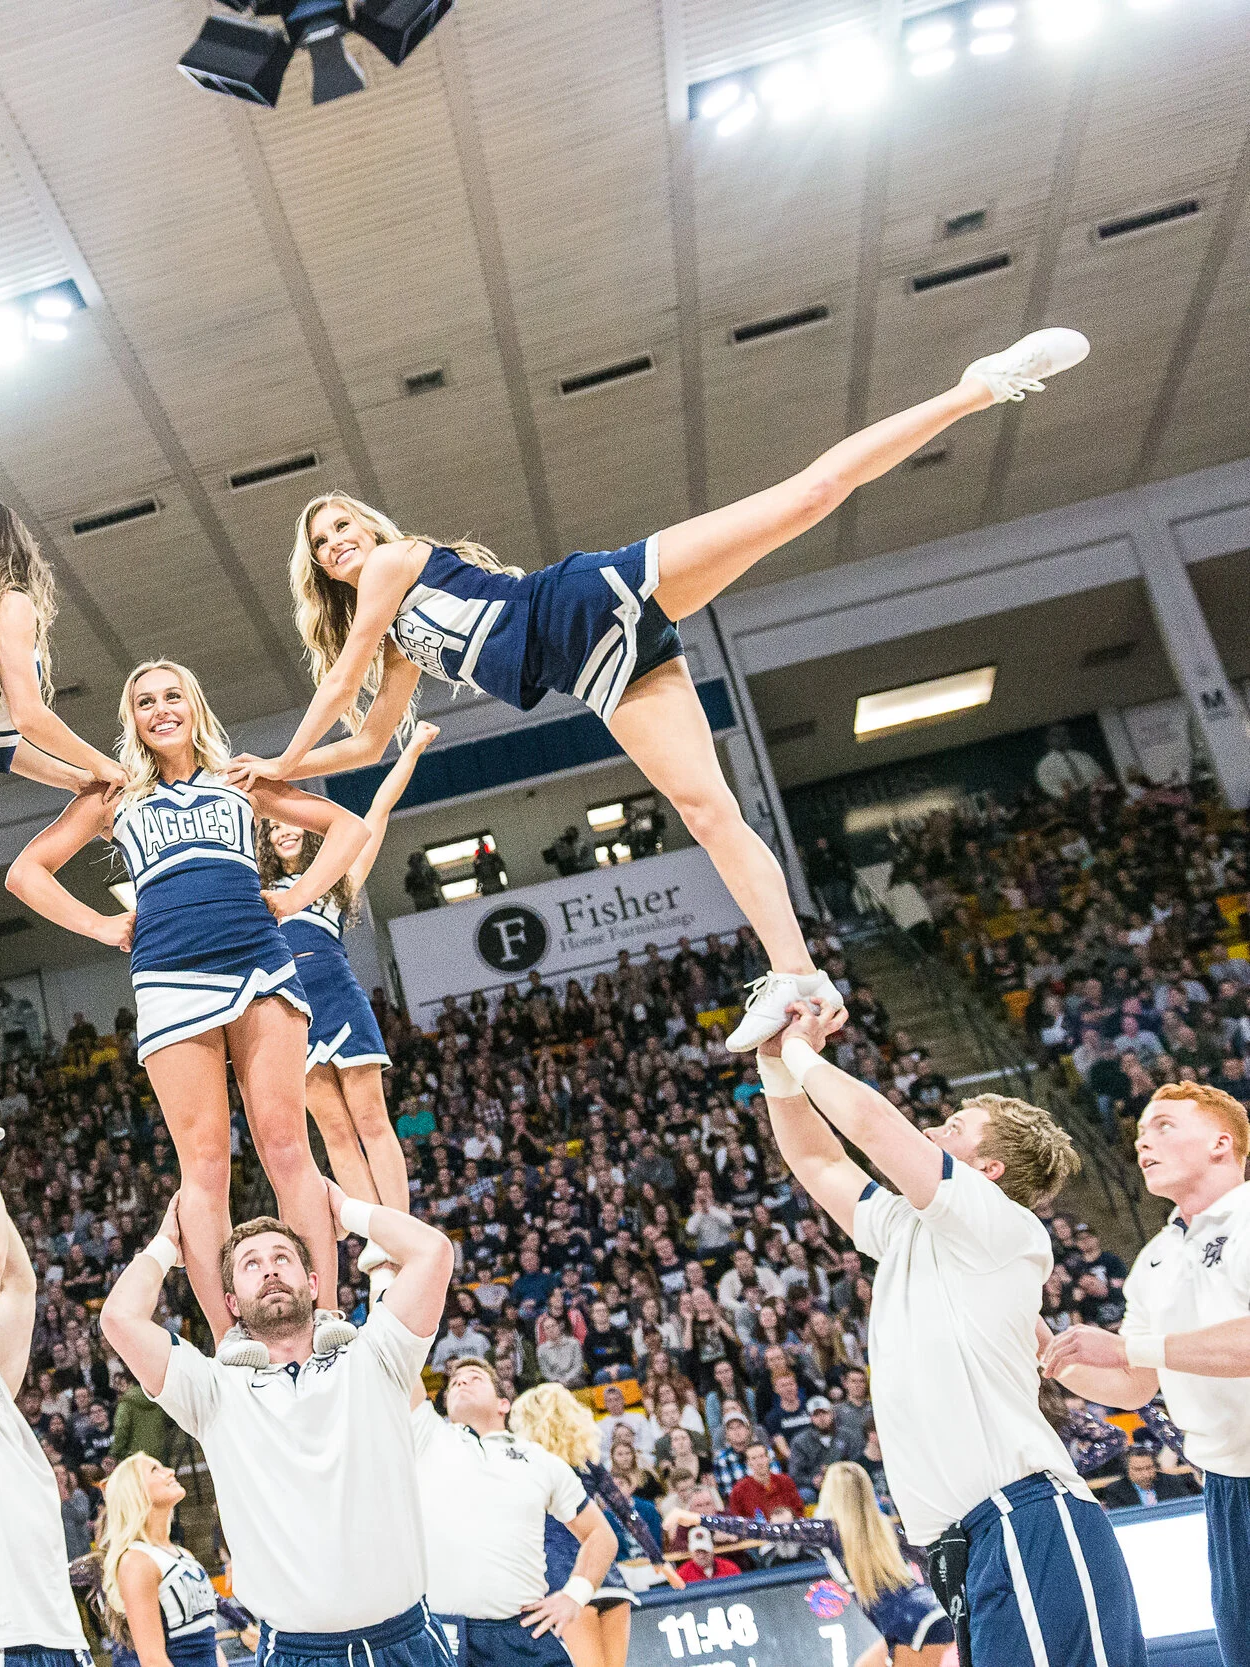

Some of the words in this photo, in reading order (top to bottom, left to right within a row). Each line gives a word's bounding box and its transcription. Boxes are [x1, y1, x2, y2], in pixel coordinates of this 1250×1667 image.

[141, 799, 236, 858] AGGIES
[557, 886, 680, 934] Fisher
[558, 935, 604, 952] Home
[607, 912, 696, 941] Furnishings
[492, 916, 527, 963] F
[657, 1603, 759, 1658] 11:48
